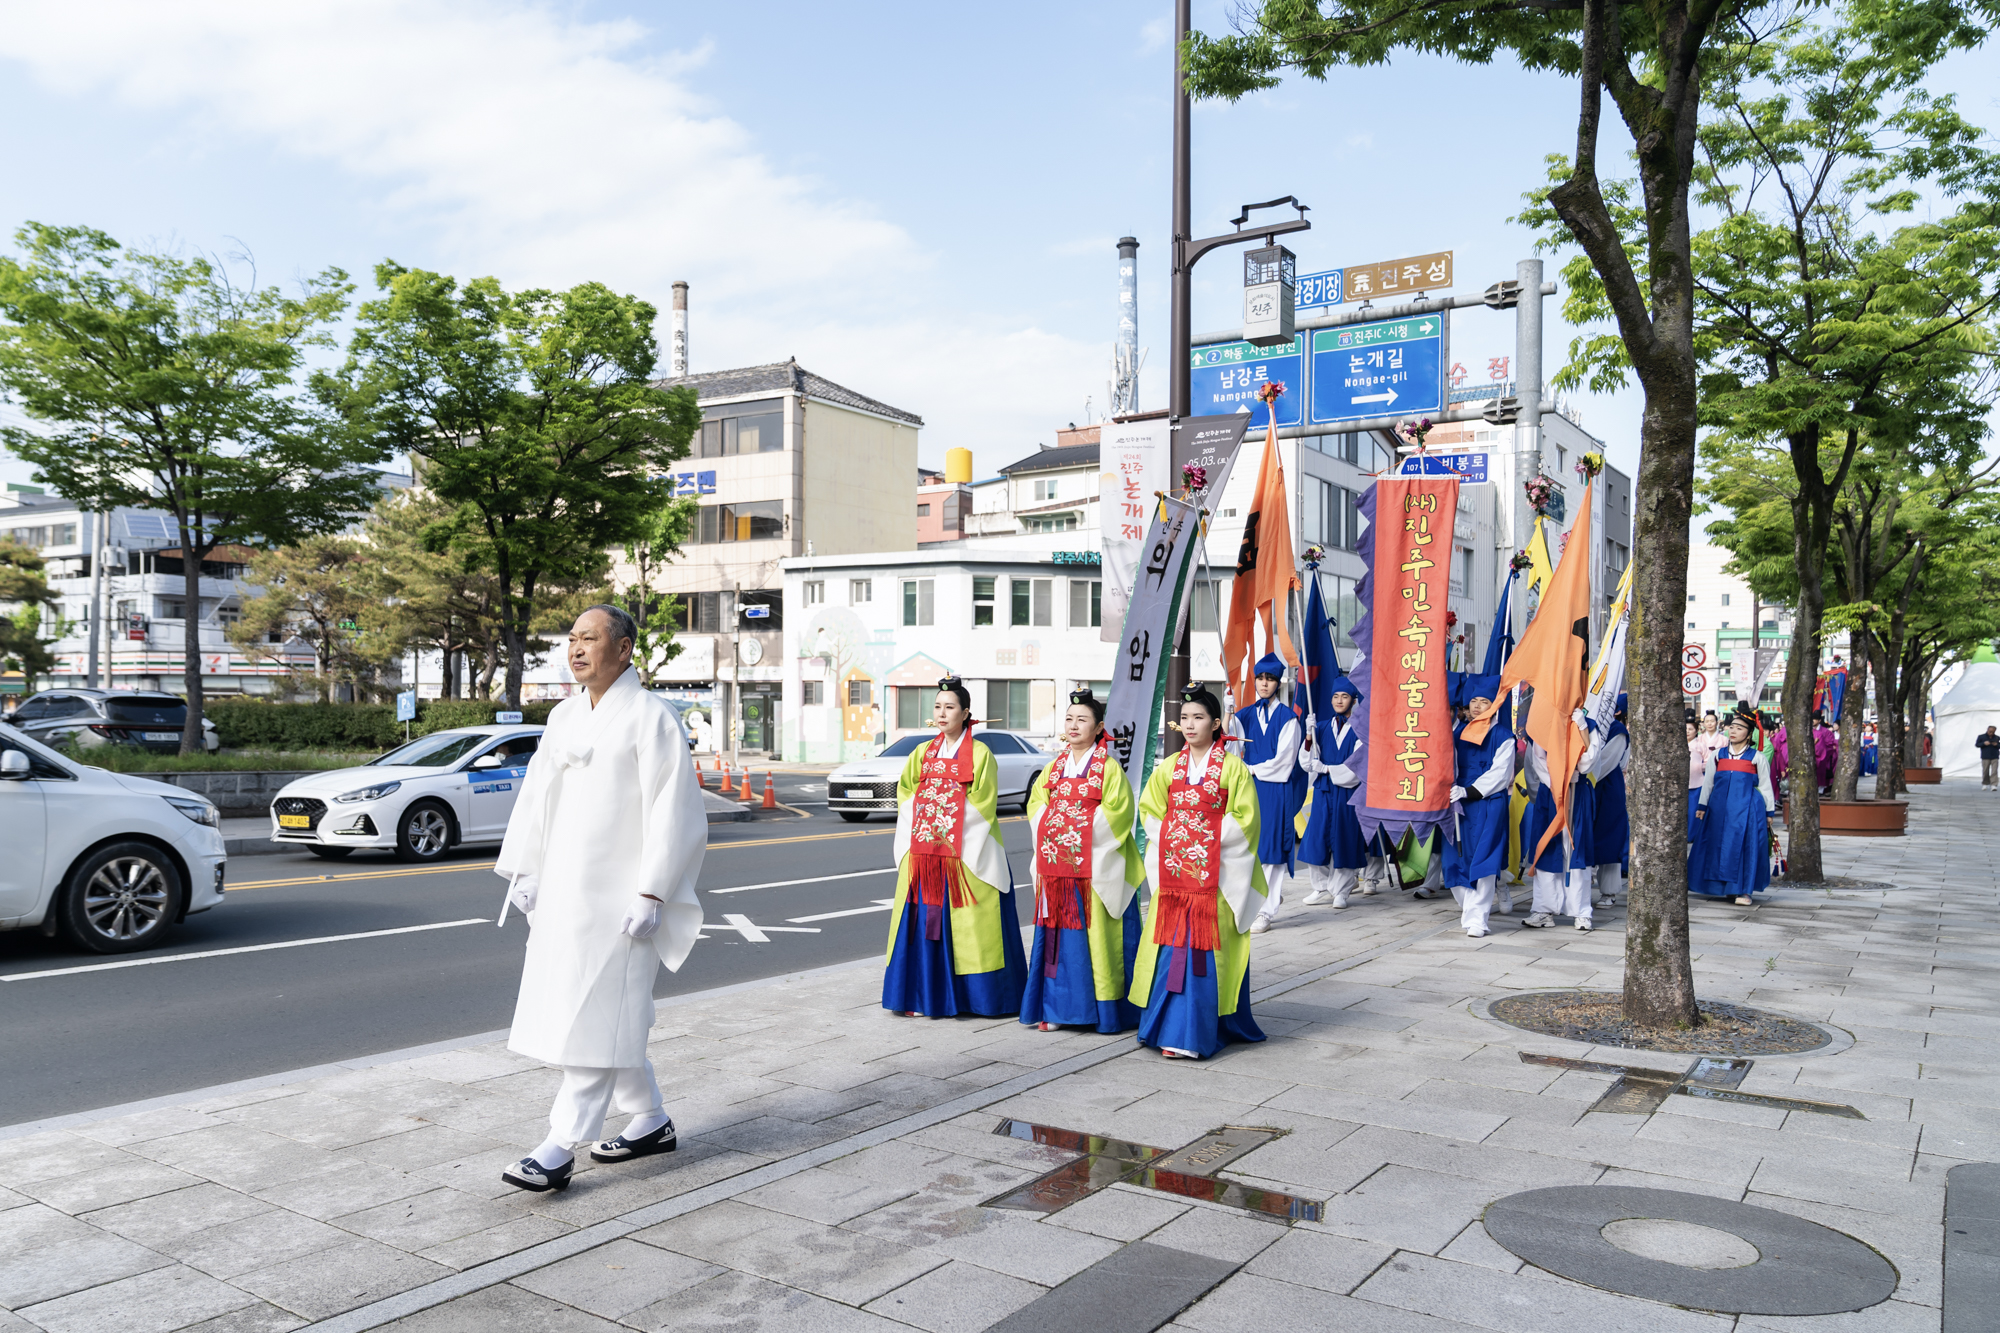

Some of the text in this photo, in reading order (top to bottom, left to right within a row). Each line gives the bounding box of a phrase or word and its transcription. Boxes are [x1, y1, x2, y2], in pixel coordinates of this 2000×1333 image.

[1380, 259, 1446, 289] 진주성
[1251, 303, 1273, 316] 진주
[1342, 337, 1349, 345] 10
[1211, 352, 1218, 361] 2
[1348, 348, 1403, 373] 논개길
[1220, 365, 1269, 389] 남강로
[1344, 371, 1408, 388] Nongae-gil
[1202, 447, 1216, 455] 2025
[1120, 462, 1144, 475] 진주
[1442, 455, 1485, 471] 비봉로
